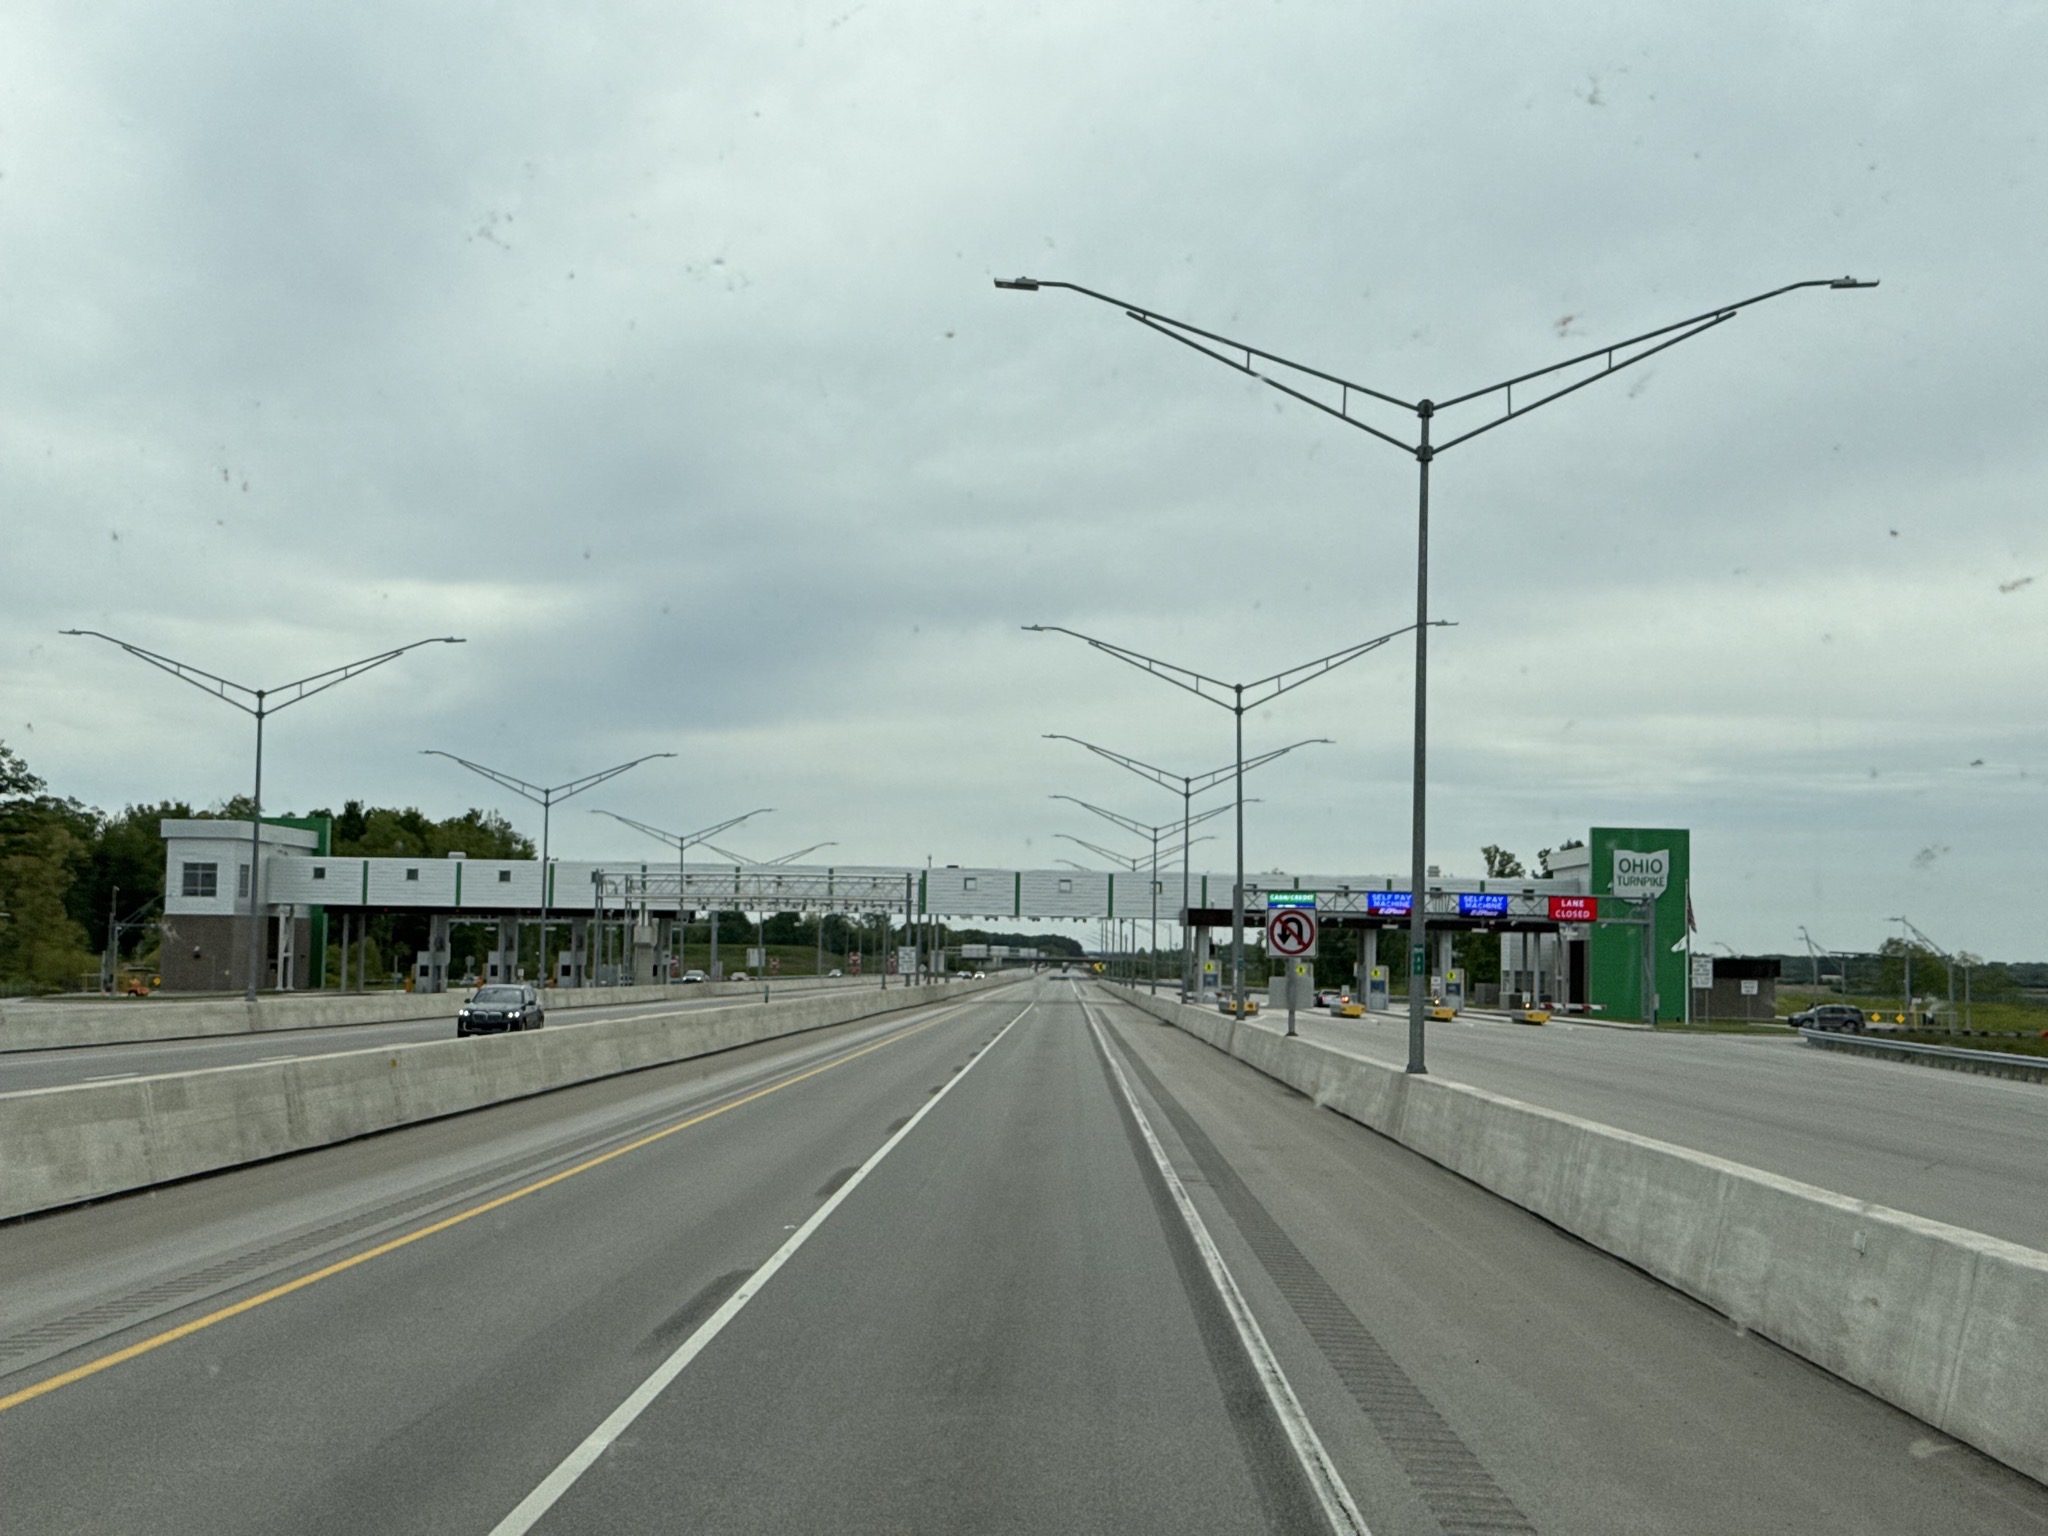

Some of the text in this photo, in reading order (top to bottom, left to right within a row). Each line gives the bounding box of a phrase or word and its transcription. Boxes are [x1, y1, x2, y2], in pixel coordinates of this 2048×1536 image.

[1618, 858, 1663, 874] OHIO
[1617, 875, 1665, 887] TURNPIKE
[1371, 894, 1412, 902] SELF PAY
[1463, 895, 1504, 903] SELF PAY
[1465, 902, 1503, 910] MACHINE
[1560, 899, 1585, 908] LANE
[1554, 909, 1590, 919] CLOSED
